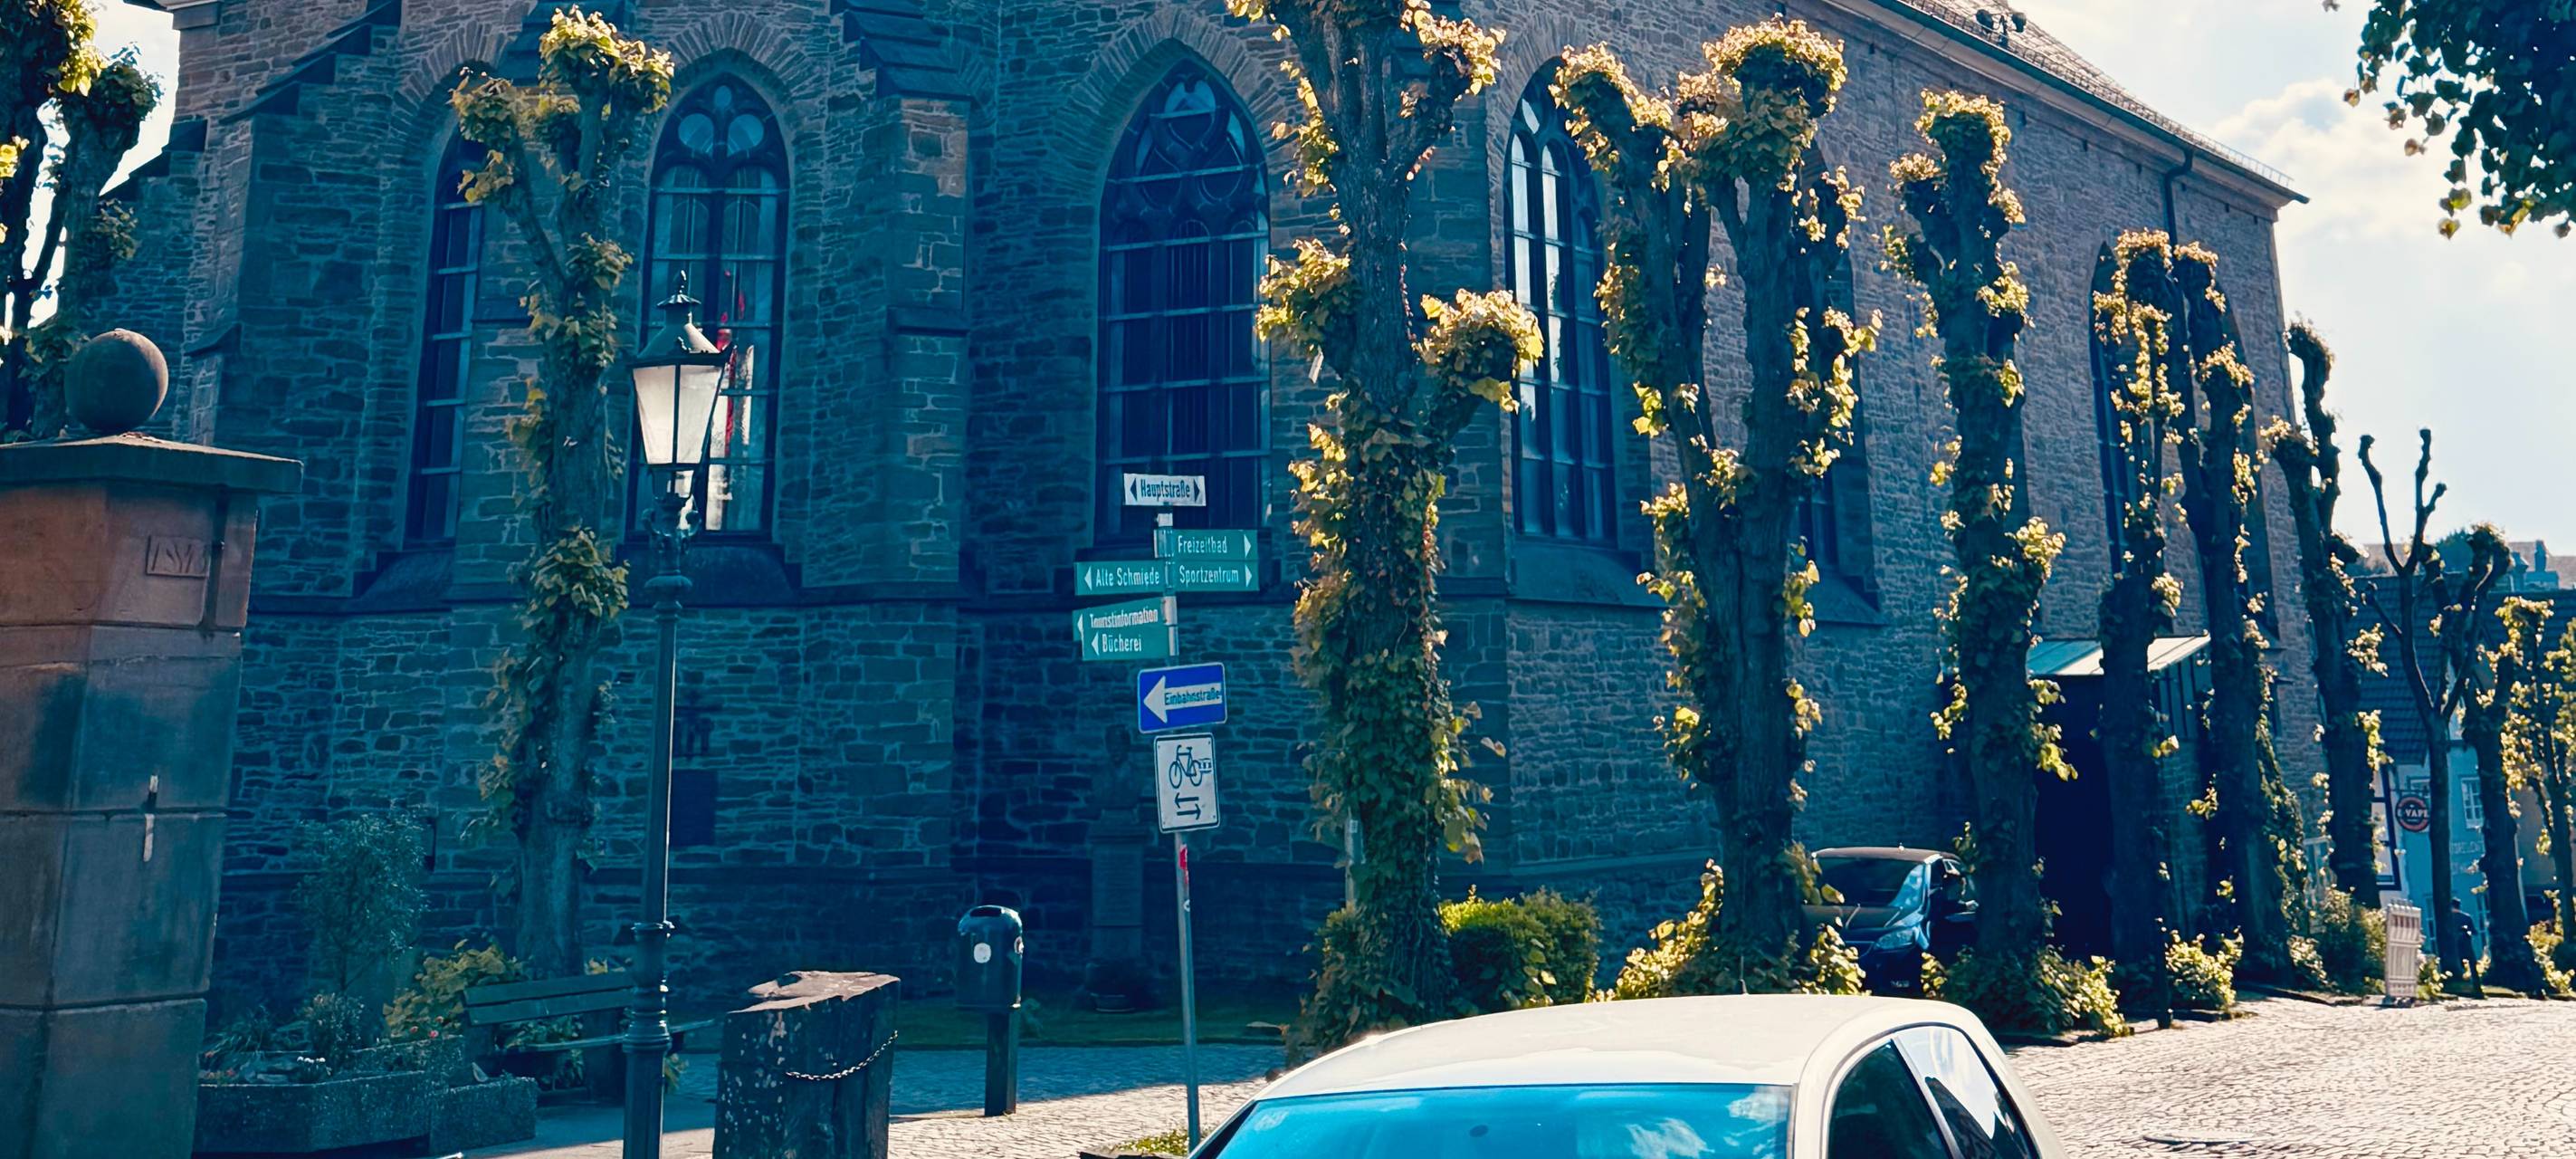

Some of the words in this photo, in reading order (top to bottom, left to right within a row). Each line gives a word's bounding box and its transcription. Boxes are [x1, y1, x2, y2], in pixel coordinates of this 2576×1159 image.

[1140, 479, 1190, 501] Hauptstraße
[1178, 535, 1227, 554] Freizeitbad
[1096, 569, 1114, 588] Alte
[1117, 566, 1159, 587] Schmiede
[1179, 564, 1239, 587] Sportzentrum
[1090, 607, 1159, 628] Touristinformation
[1102, 633, 1141, 653] Bücherei
[1165, 687, 1221, 705] Einbahnstraße
